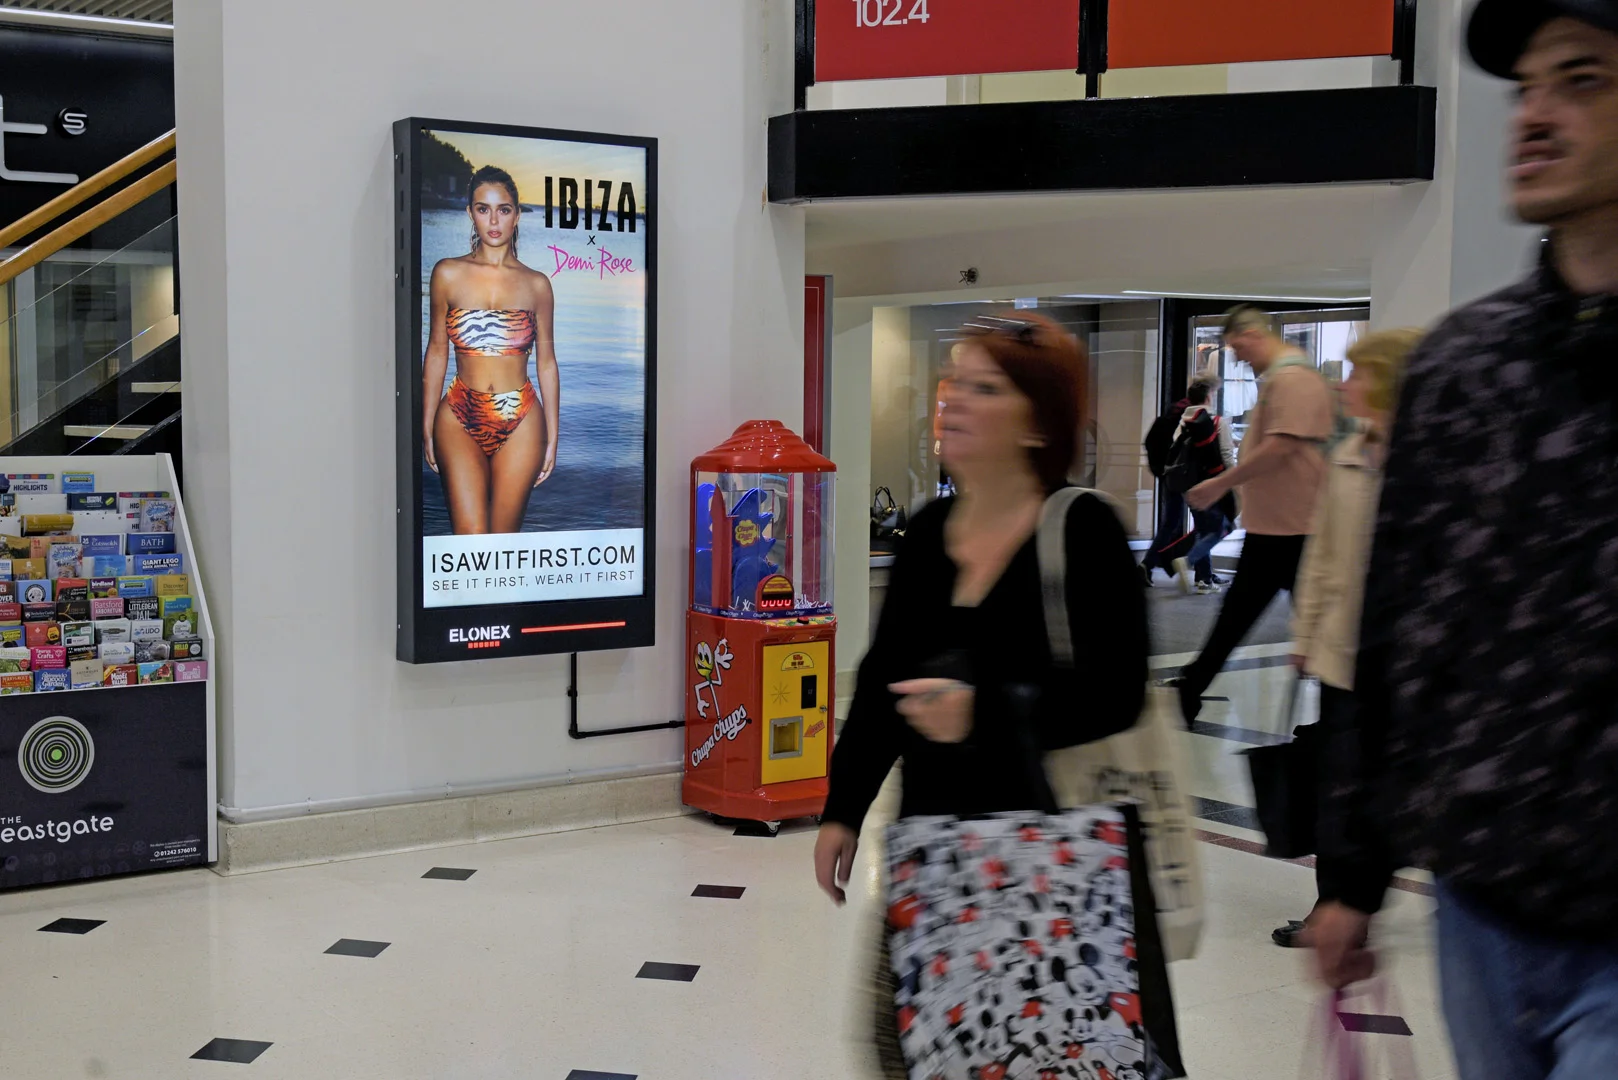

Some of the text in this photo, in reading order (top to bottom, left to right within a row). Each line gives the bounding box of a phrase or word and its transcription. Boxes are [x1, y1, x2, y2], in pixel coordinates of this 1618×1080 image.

[852, 0, 930, 28] 102.4
[545, 176, 636, 233] IBIZA
[547, 244, 636, 280] Demi Rose
[141, 538, 164, 547] BATH
[432, 545, 635, 573] ISAWITFIRST.COM
[91, 579, 114, 587] birdland
[432, 580, 459, 591] SEE
[466, 579, 479, 589] IT
[535, 574, 573, 585] WEAR
[580, 572, 592, 583] IT
[597, 570, 635, 581] FIRST
[135, 611, 152, 620] JAIL
[449, 625, 511, 643] ELONEX
[691, 704, 748, 767] Chupa Chups
[1, 816, 21, 825] THE
[1, 815, 114, 843] eastgate
